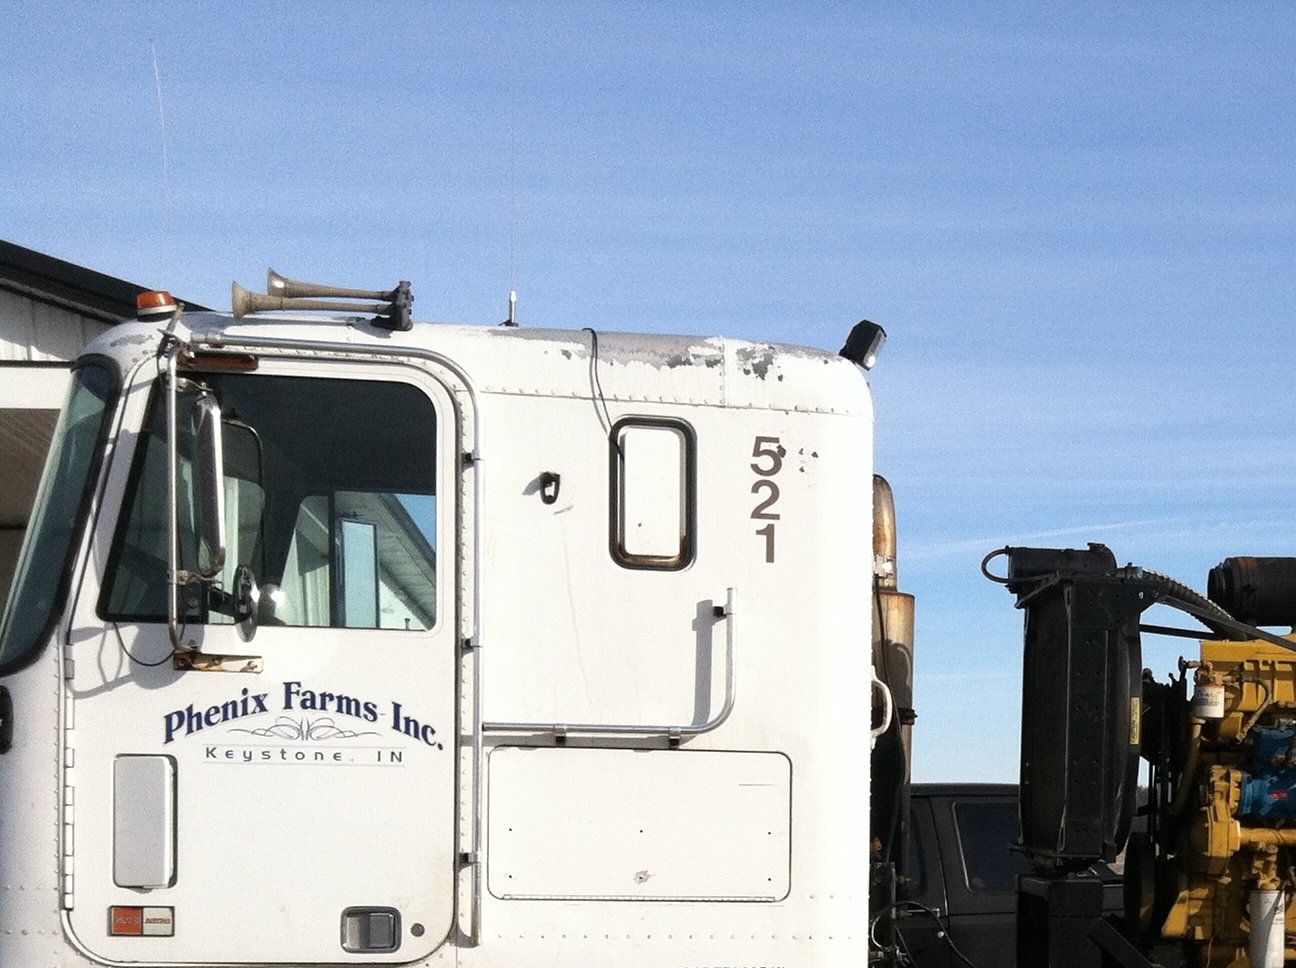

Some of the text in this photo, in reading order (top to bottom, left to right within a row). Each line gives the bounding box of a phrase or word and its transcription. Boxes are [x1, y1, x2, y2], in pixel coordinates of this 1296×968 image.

[163, 682, 443, 750] Phenix Farms Inc.
[377, 751, 402, 763] IN
